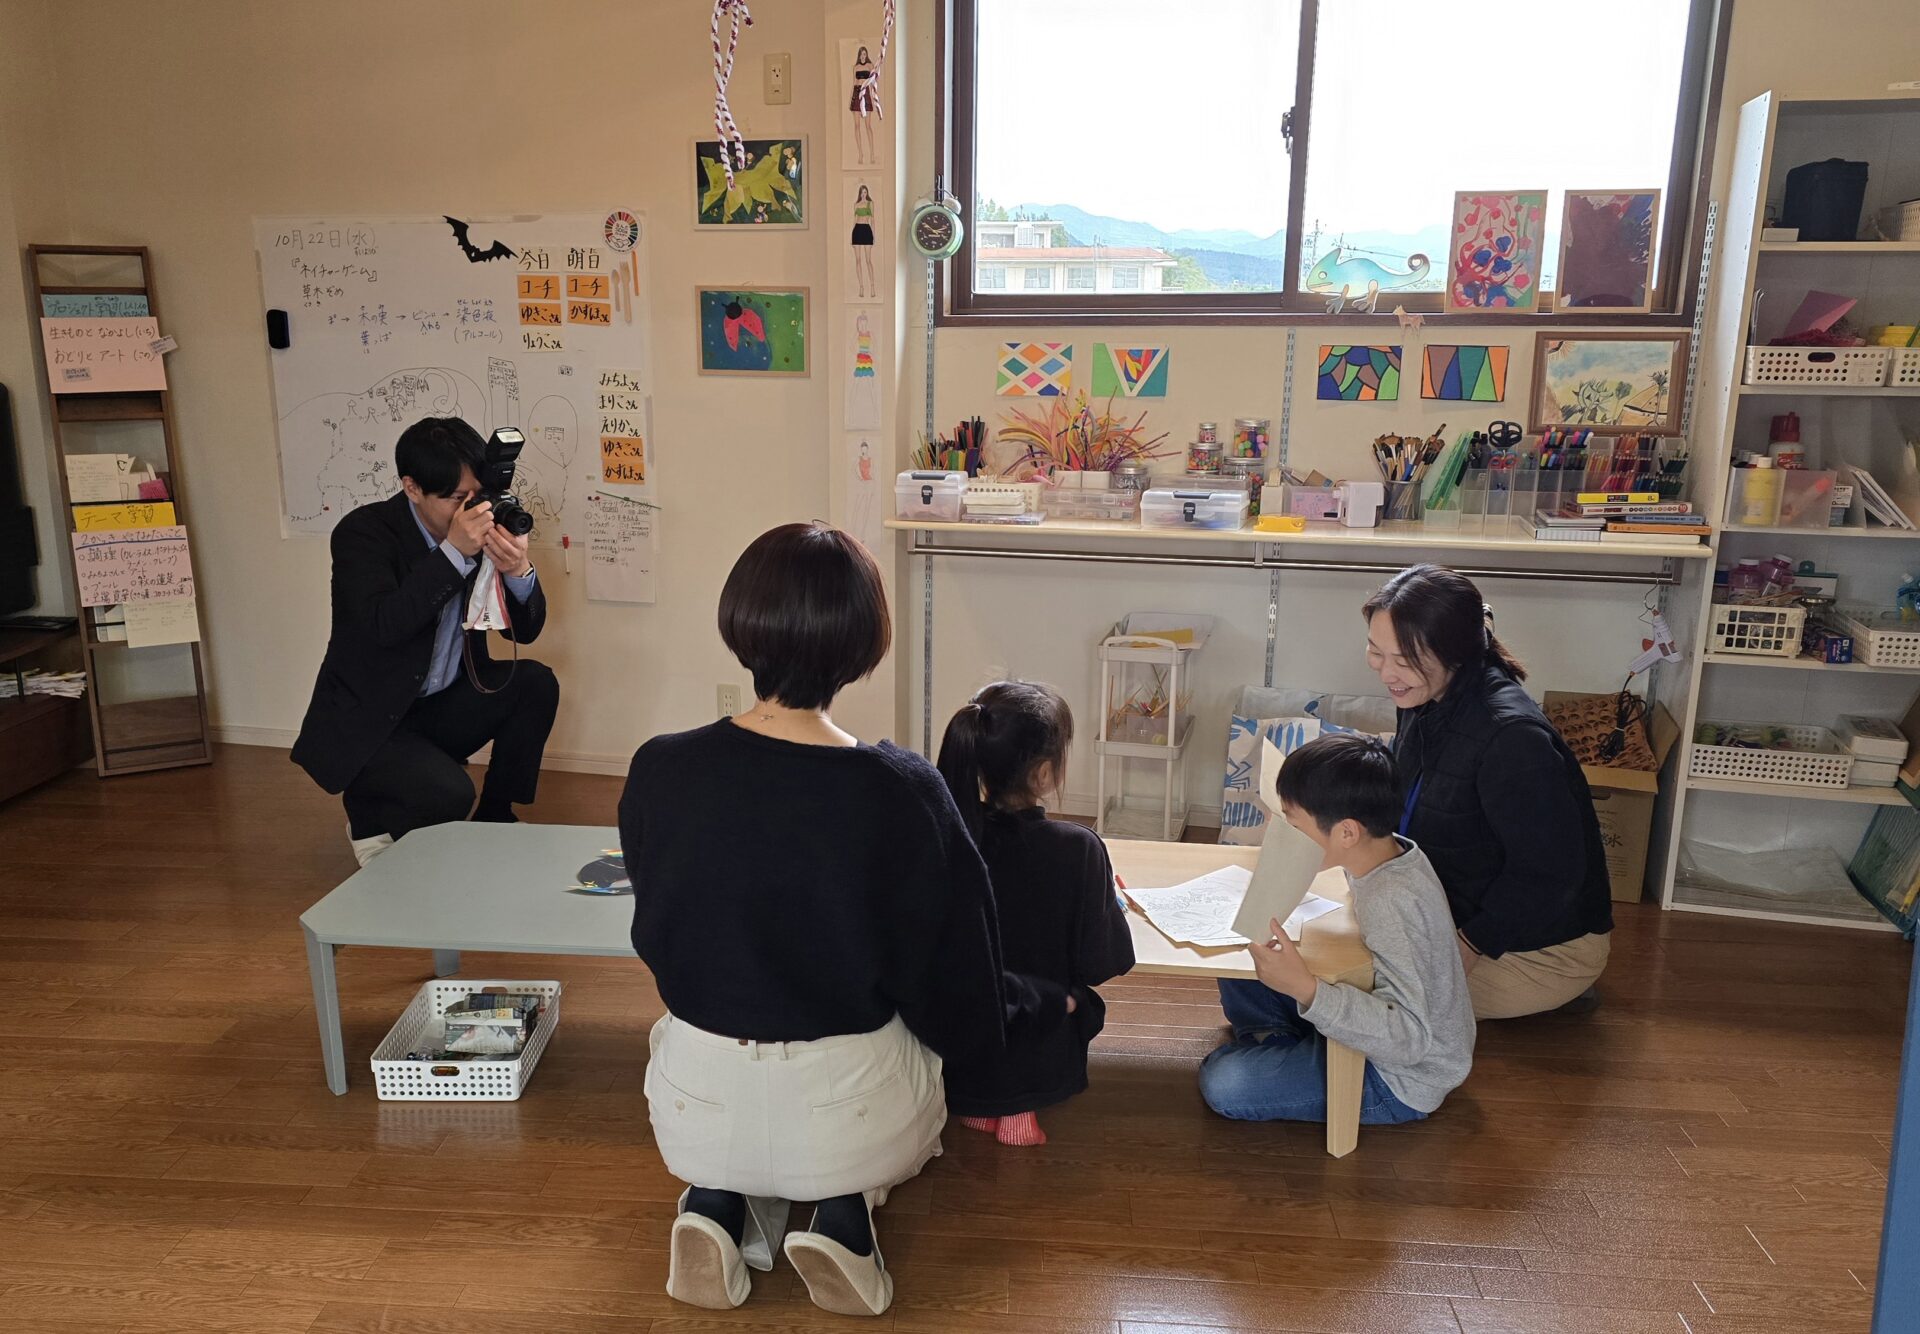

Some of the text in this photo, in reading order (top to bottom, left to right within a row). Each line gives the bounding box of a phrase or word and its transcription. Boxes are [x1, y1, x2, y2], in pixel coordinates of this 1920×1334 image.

[519, 251, 549, 270] 今日
[567, 251, 600, 270] 明日
[521, 279, 555, 300] コーチ
[567, 277, 603, 296] コーチ
[521, 305, 562, 324] ゆきこさん
[599, 372, 641, 391] みちよさん
[599, 394, 639, 410] まりこさん
[600, 416, 641, 437] えりかさん
[603, 440, 643, 458] ゆきこさん
